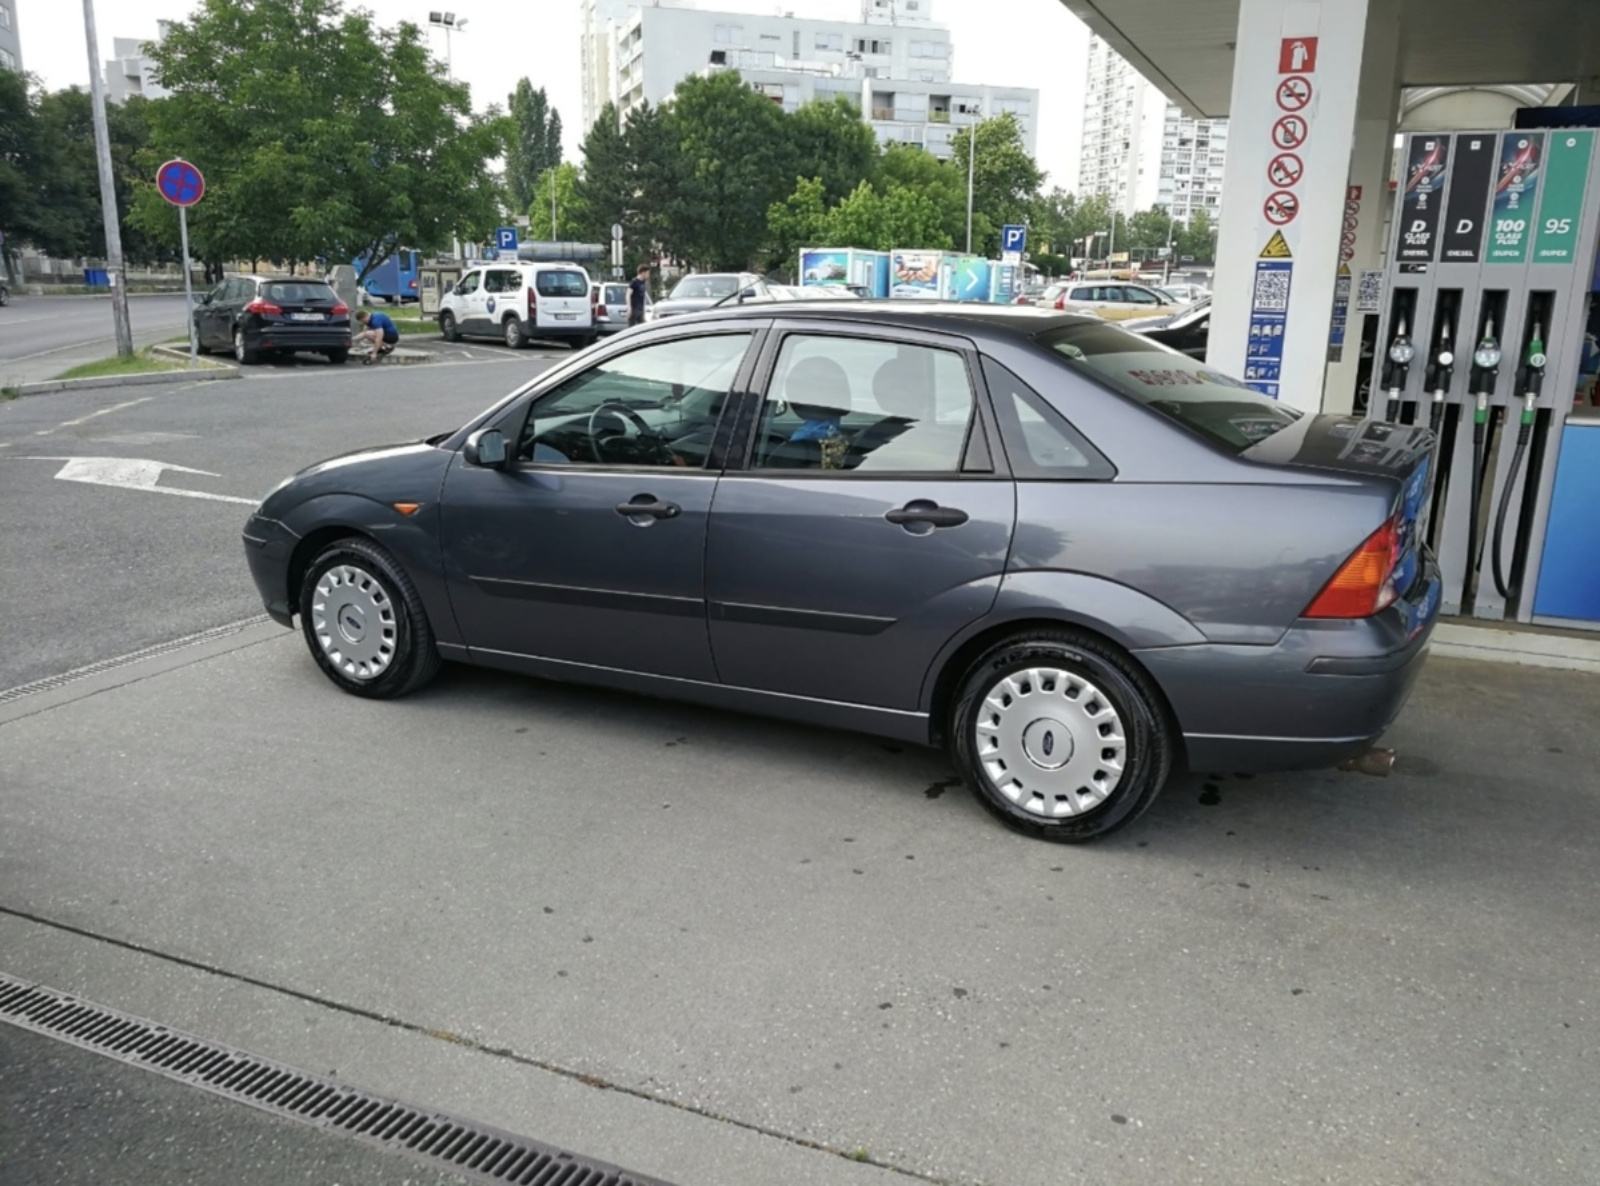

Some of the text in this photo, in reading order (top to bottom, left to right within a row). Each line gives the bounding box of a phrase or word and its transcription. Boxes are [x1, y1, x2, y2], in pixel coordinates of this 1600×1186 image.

[1410, 219, 1427, 233] D
[1456, 219, 1473, 234] D
[1496, 219, 1526, 232] 100
[1544, 218, 1572, 234] 95
[501, 231, 513, 247] P
[1008, 230, 1020, 247] P
